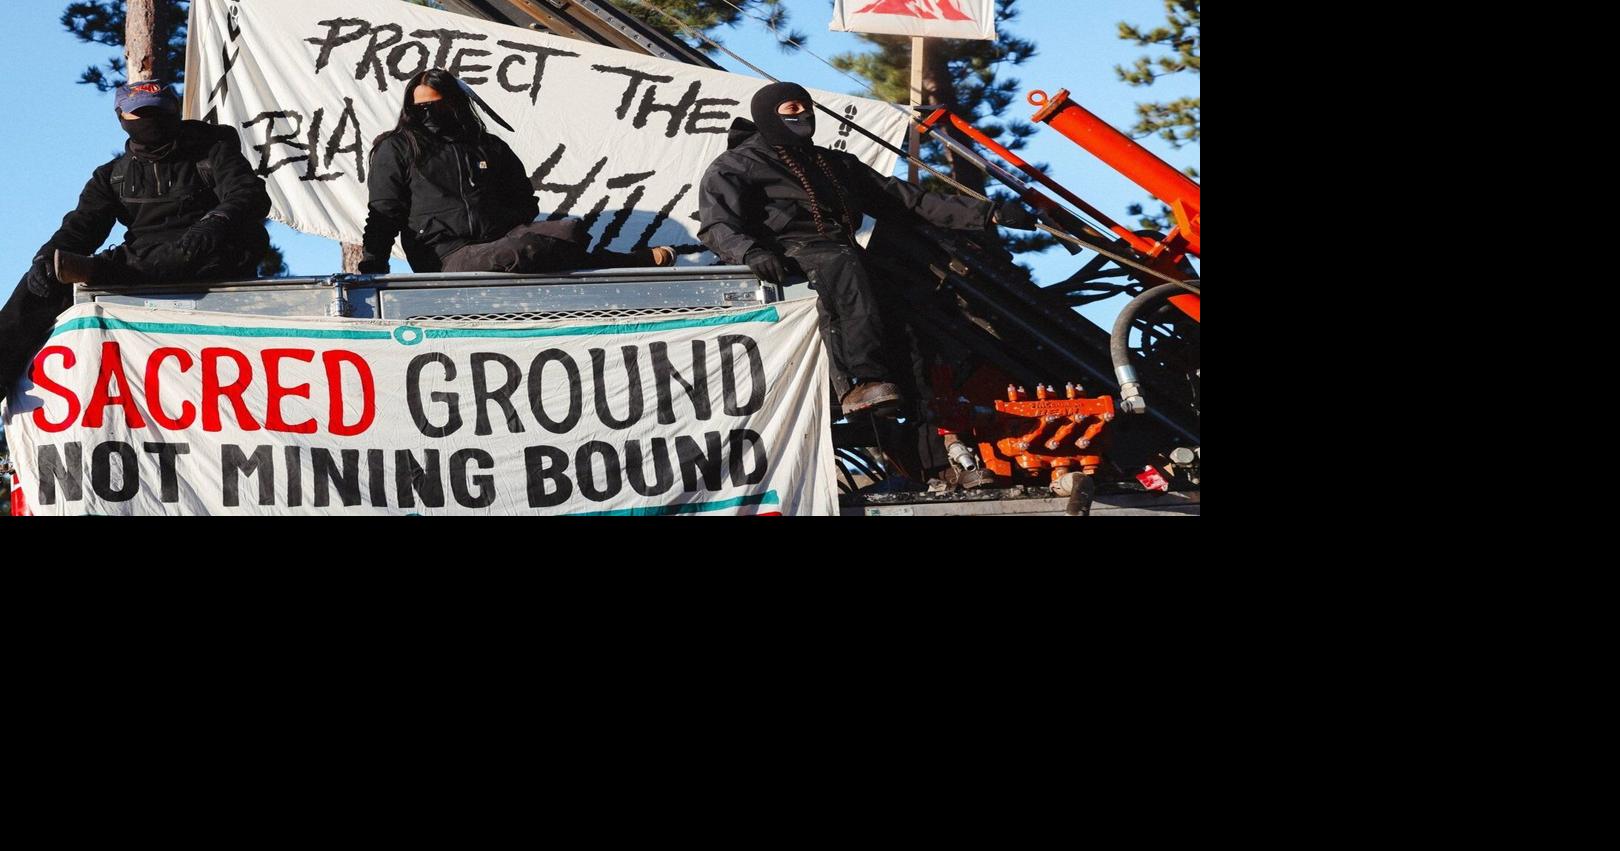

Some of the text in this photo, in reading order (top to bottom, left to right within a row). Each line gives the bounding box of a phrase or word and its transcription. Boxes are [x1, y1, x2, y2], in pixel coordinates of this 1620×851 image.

[304, 17, 740, 138] PROTECT THE
[239, 96, 708, 254] BLA HILL
[29, 334, 767, 438] SACRED GROUND
[37, 429, 768, 508] NOT MINING BOUND
